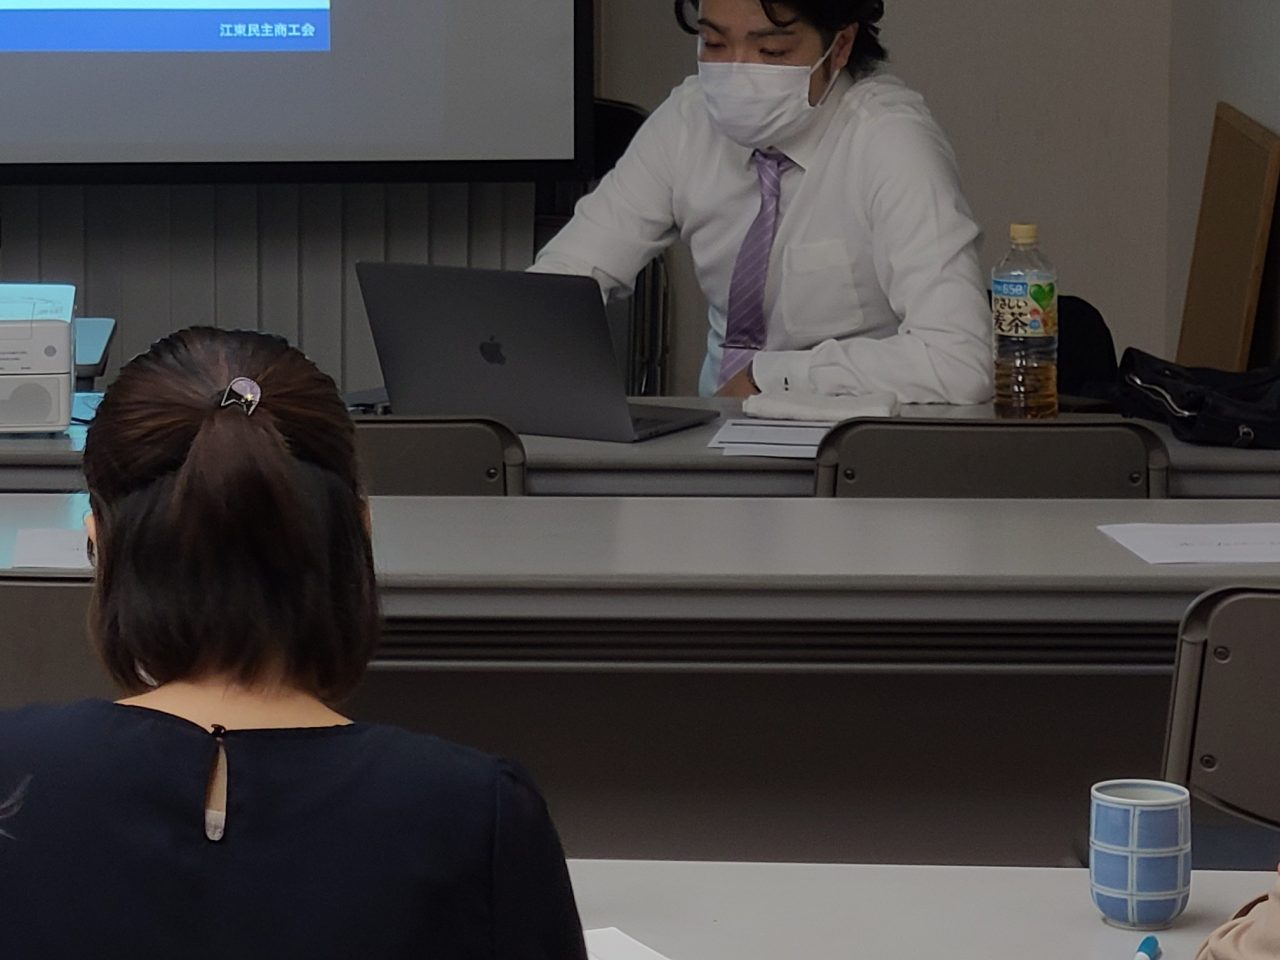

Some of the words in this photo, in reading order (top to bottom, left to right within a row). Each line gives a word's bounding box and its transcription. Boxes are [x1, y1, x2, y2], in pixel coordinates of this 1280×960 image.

[219, 22, 316, 39] 江東民主商工会
